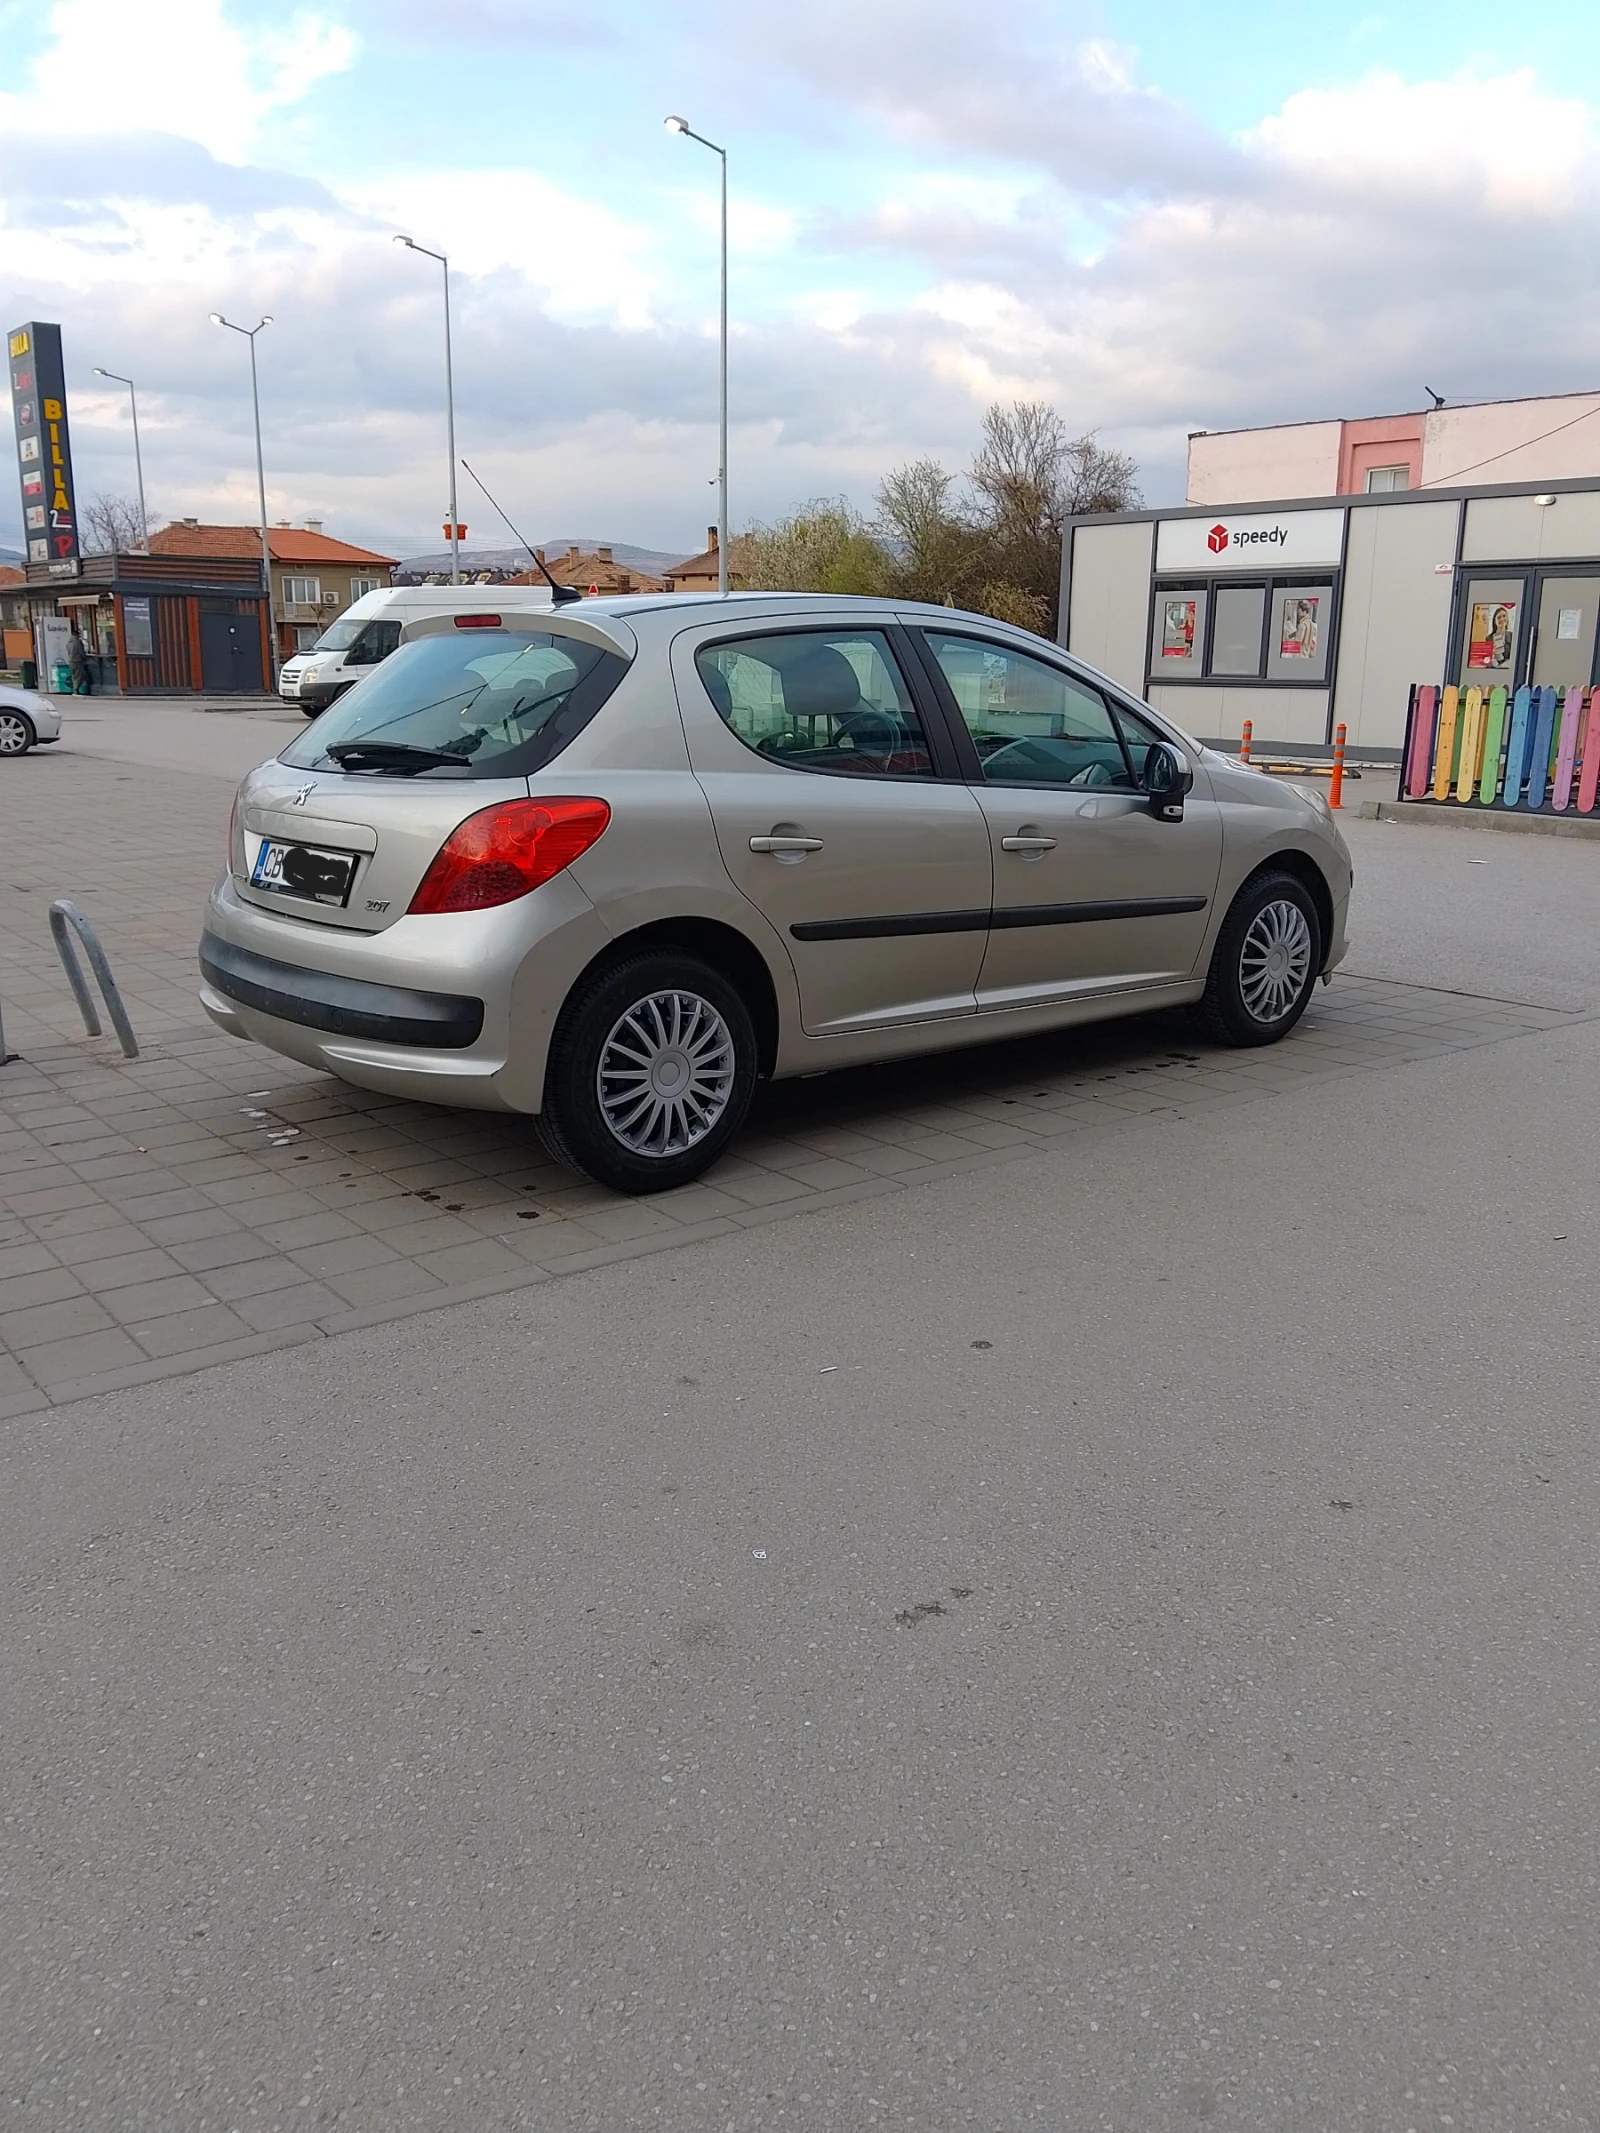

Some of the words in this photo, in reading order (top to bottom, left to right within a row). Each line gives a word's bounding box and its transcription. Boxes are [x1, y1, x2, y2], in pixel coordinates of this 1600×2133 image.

[9, 332, 30, 358] BILLA
[44, 398, 70, 510] BILLA
[54, 535, 74, 558] P
[1233, 526, 1288, 548] speedy
[365, 899, 391, 913] 207
